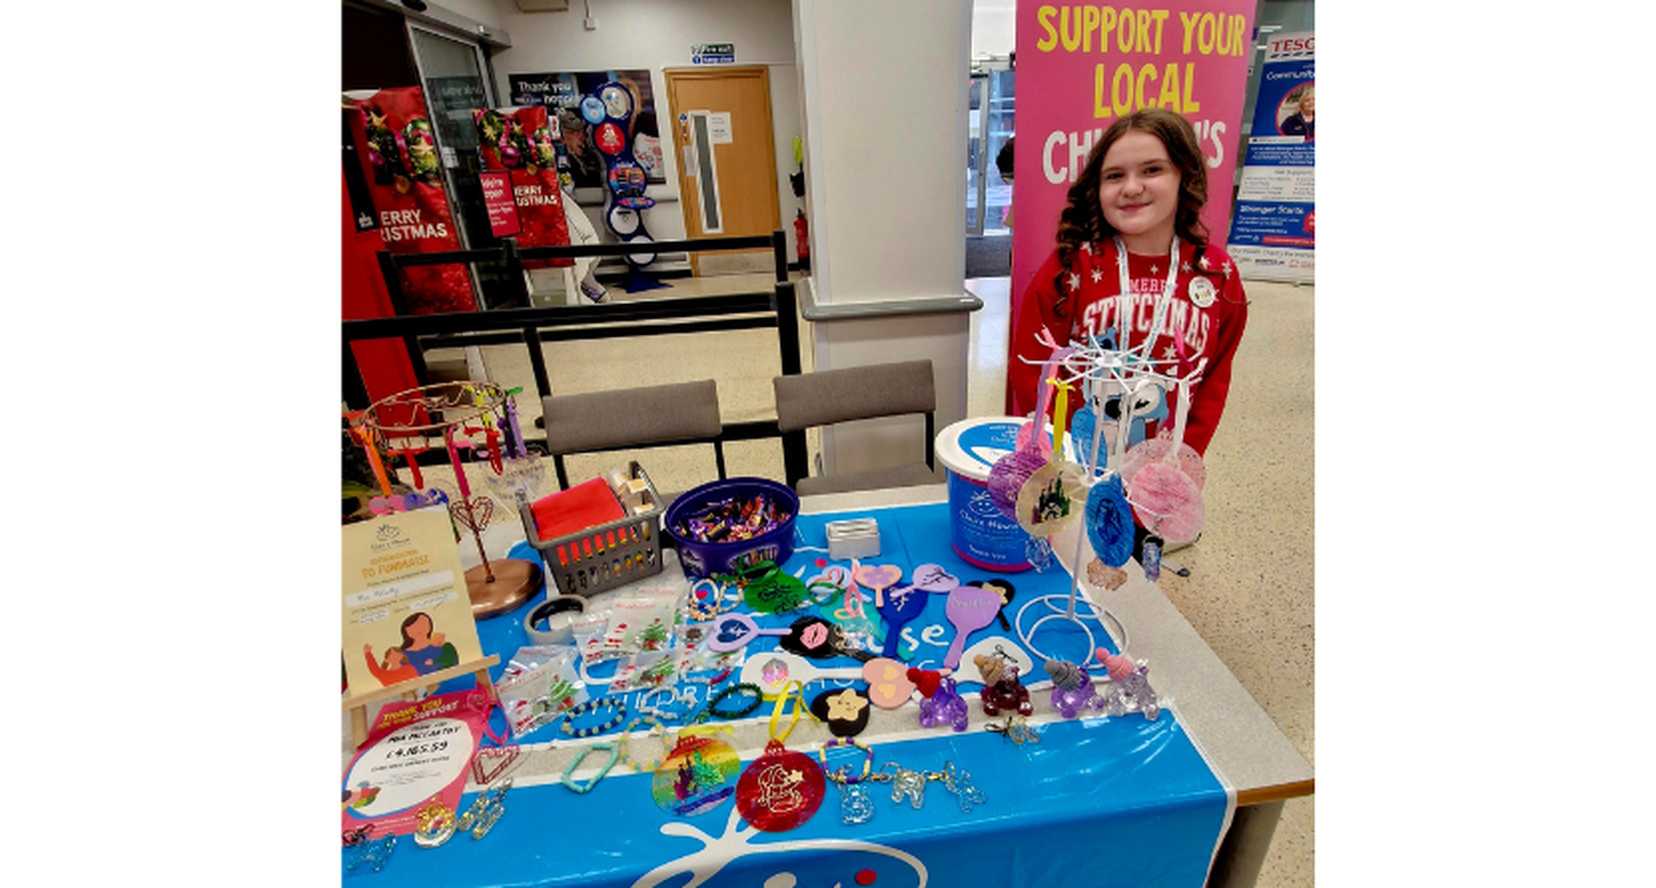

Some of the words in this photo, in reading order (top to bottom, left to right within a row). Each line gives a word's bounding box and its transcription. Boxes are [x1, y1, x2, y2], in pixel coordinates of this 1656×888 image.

[1037, 5, 1169, 55] SUPPORT
[1180, 11, 1246, 57] YOUR
[1271, 37, 1315, 52] TESC
[1266, 70, 1315, 81] Communit
[1093, 62, 1200, 118] LOCAL
[513, 185, 542, 196] ERRY
[516, 194, 558, 207] ISTMAS
[380, 208, 421, 226] ERRY
[380, 222, 448, 242] ISTMAS
[1129, 277, 1168, 293] MERR
